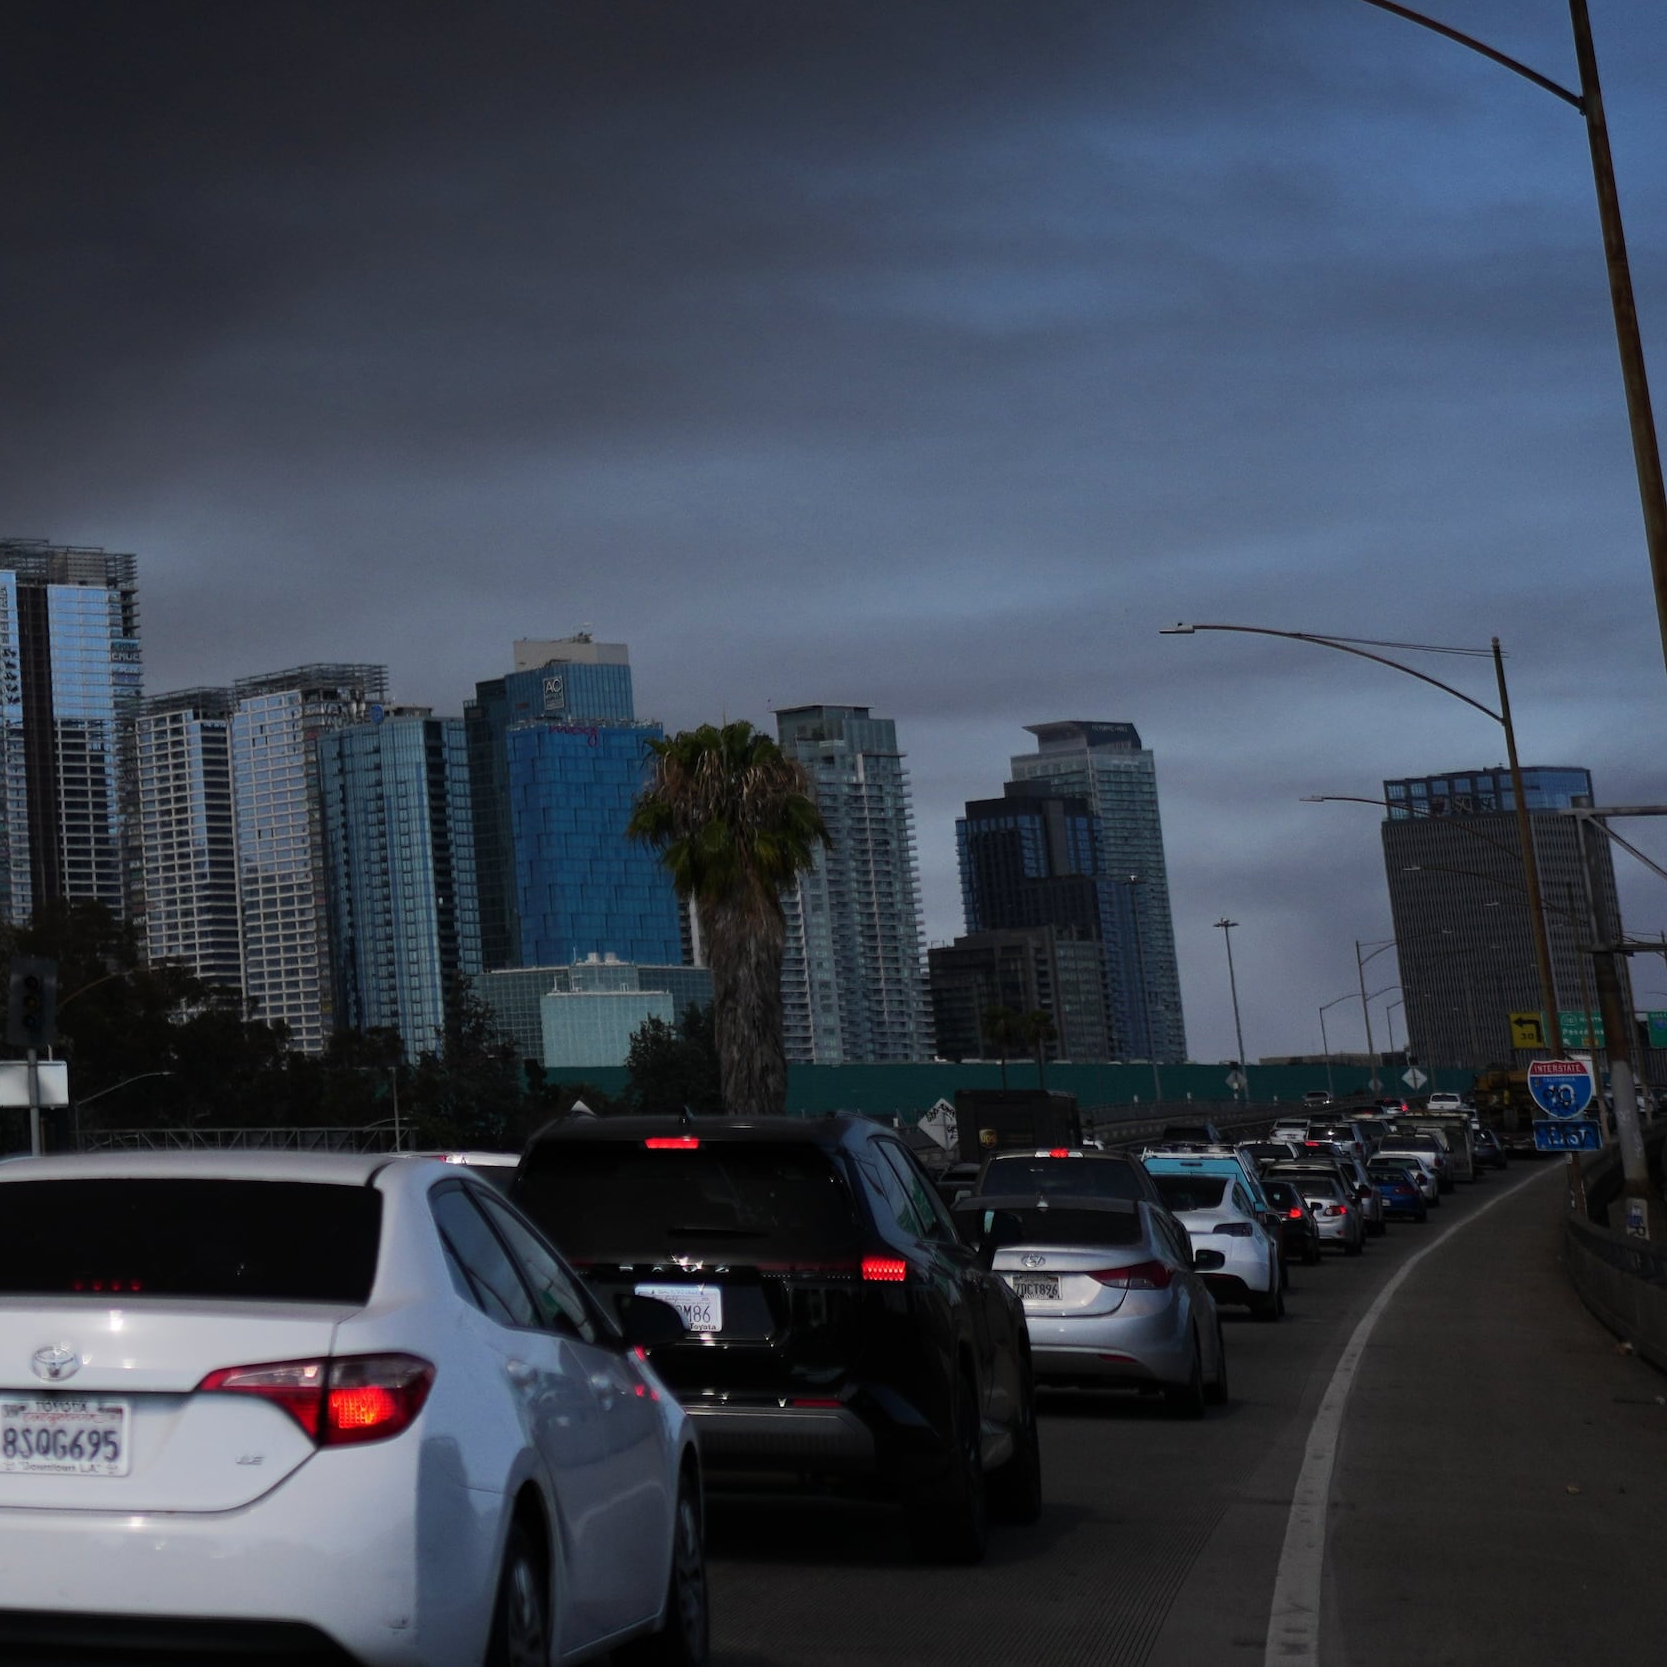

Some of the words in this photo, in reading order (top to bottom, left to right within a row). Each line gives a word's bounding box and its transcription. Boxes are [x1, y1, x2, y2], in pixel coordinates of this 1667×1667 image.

[1533, 1064, 1582, 1074] INTERSTATE
[1014, 1283, 1058, 1296] 7DCT896
[690, 1322, 717, 1332] Toyota
[35, 1401, 85, 1412] TOYOTA
[3, 1428, 118, 1461] 8SQG695
